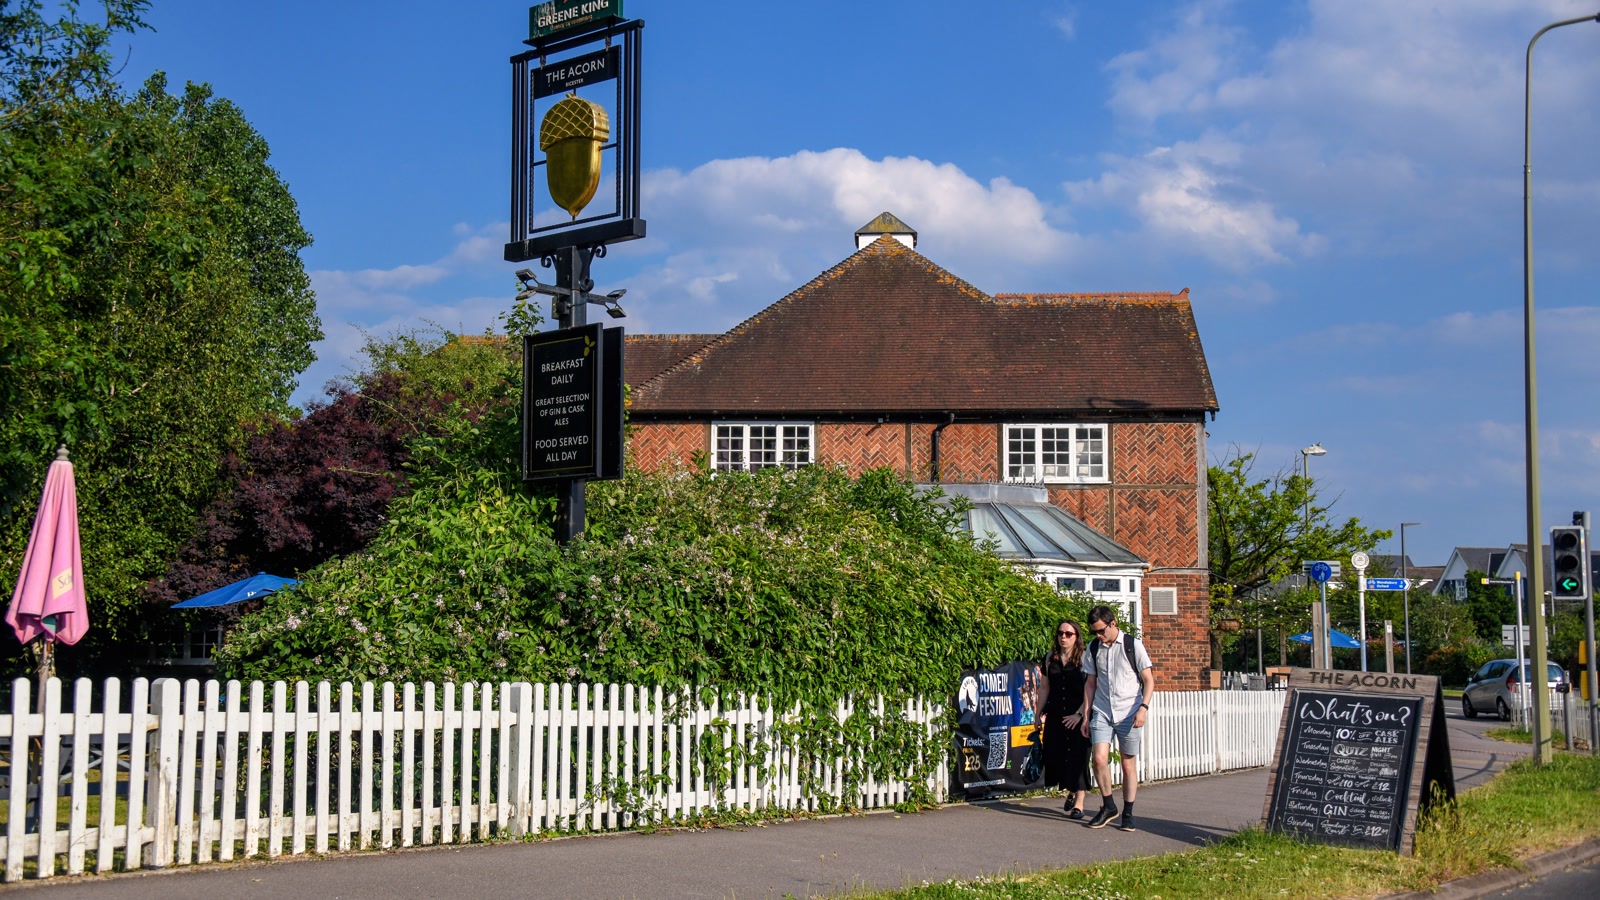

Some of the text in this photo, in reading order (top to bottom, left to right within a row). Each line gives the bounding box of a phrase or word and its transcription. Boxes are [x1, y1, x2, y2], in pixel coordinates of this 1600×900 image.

[538, 6, 578, 28] GREENE
[581, 0, 609, 15] KING
[546, 58, 605, 84] THE ACORN
[542, 358, 584, 372] BREAKFAST
[551, 373, 574, 385] DAILY
[535, 393, 590, 406] GREAT SELECTION
[540, 404, 585, 417] OF GIN & CASK
[554, 418, 569, 426] ALES
[536, 435, 589, 449] FOOD SERVED
[546, 450, 577, 462] ALL DAY
[1309, 672, 1416, 690] THE ACORN
[1300, 698, 1411, 726] What's on?
[1304, 726, 1332, 738] Monday
[1335, 728, 1356, 740] 10%
[1301, 740, 1330, 754] Tuesday
[1333, 744, 1368, 757] QUIZ
[1296, 756, 1328, 769] Wednesday
[1294, 771, 1324, 784] Thursday
[1290, 786, 1317, 799] Friday
[1288, 800, 1318, 815] Saturday
[1324, 804, 1348, 816] GIN
[1286, 816, 1314, 831] Sunday
